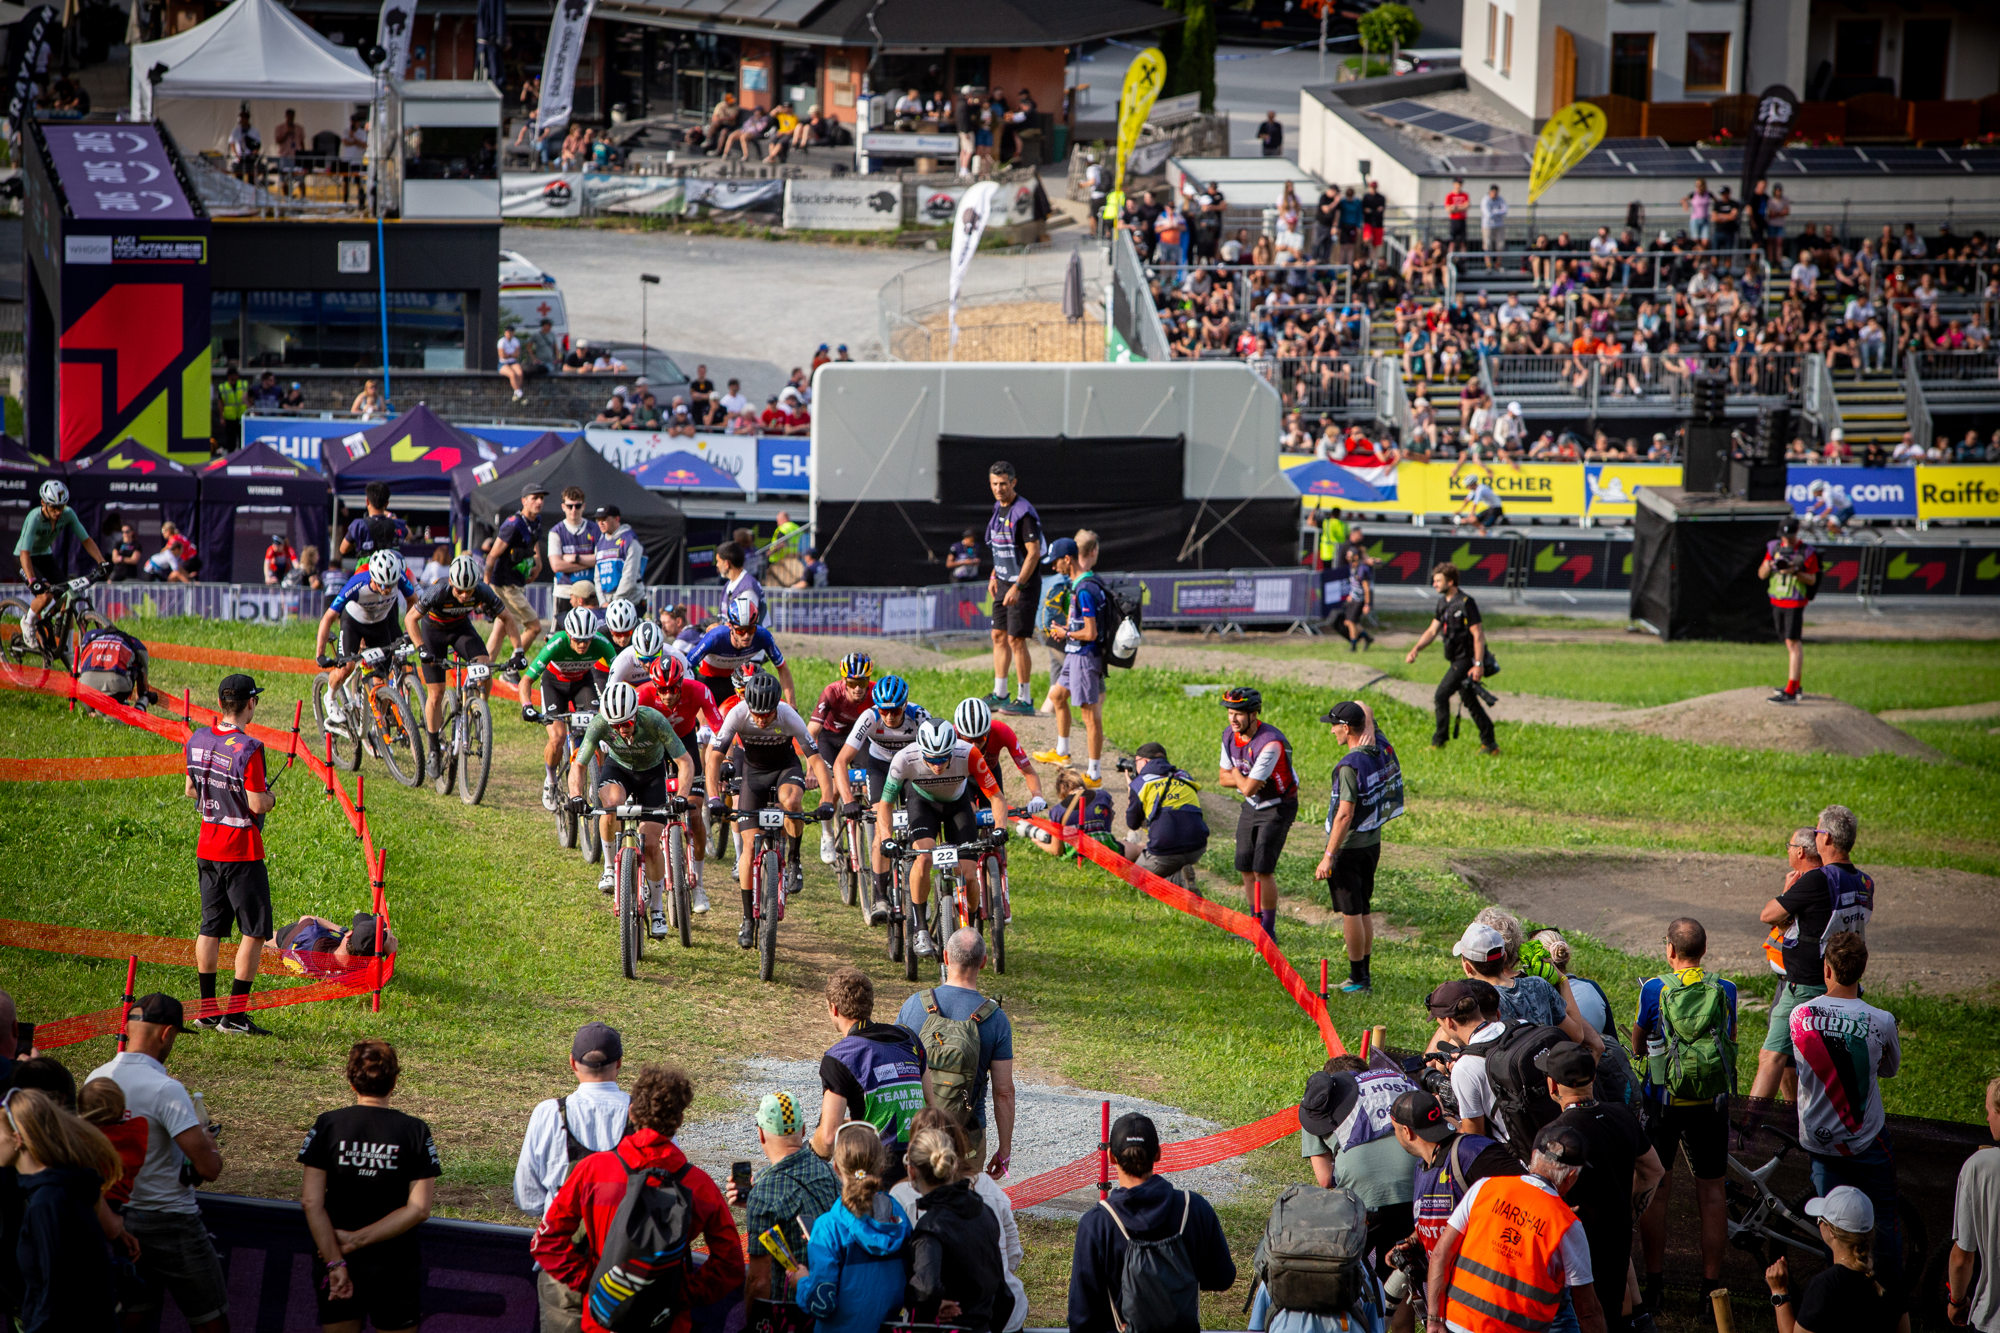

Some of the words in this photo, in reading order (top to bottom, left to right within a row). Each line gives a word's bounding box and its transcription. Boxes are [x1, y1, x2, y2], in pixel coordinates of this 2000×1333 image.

[1449, 476, 1552, 490] KRCHER
[247, 485, 283, 497] WINNER
[73, 578, 86, 588] 34
[368, 651, 379, 659] 11
[471, 667, 486, 675] 18
[576, 716, 590, 724] 13
[855, 718, 872, 742] BMC
[854, 771, 862, 780] 2
[669, 780, 676, 789] 1
[764, 815, 780, 825] 12
[981, 812, 994, 824] 15
[937, 852, 954, 862] 22
[875, 1089, 908, 1103] TEAM
[338, 1140, 400, 1170] LUKE
[357, 1168, 378, 1177] STAFF
[1492, 1198, 1546, 1237] MARSHAL
